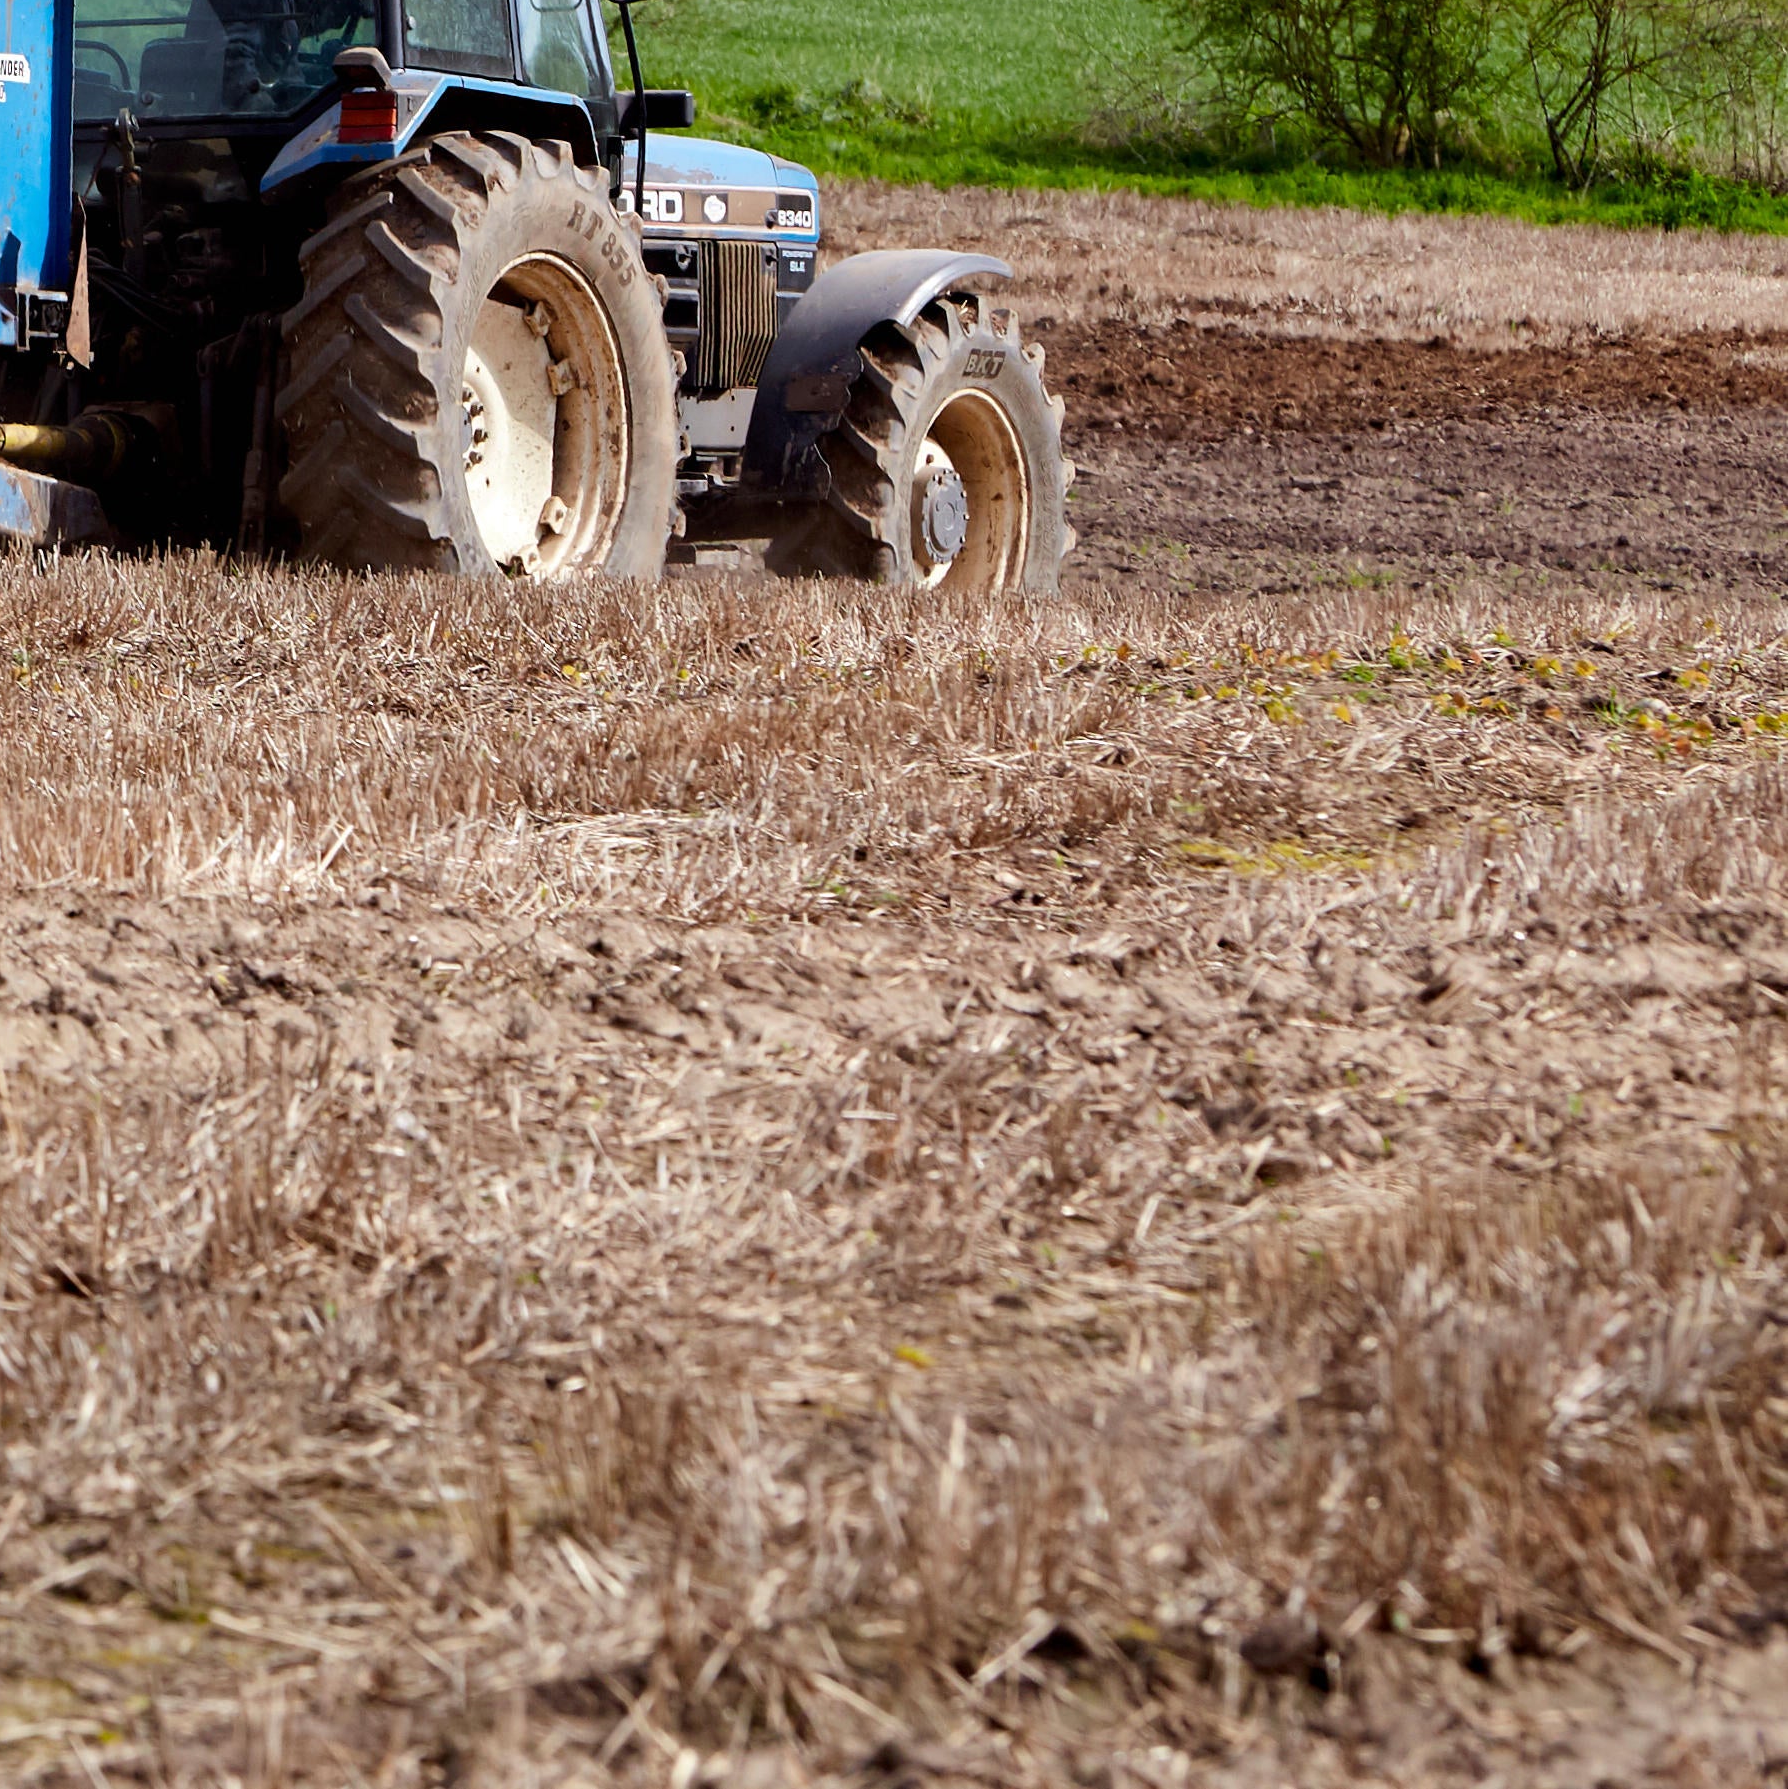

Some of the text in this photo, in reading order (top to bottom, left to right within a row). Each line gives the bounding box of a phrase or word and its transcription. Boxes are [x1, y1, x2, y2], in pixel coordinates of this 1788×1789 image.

[615, 189, 683, 222] ORD
[778, 209, 812, 228] 8340
[567, 199, 637, 286] RT 855
[964, 350, 1005, 377] BKT
